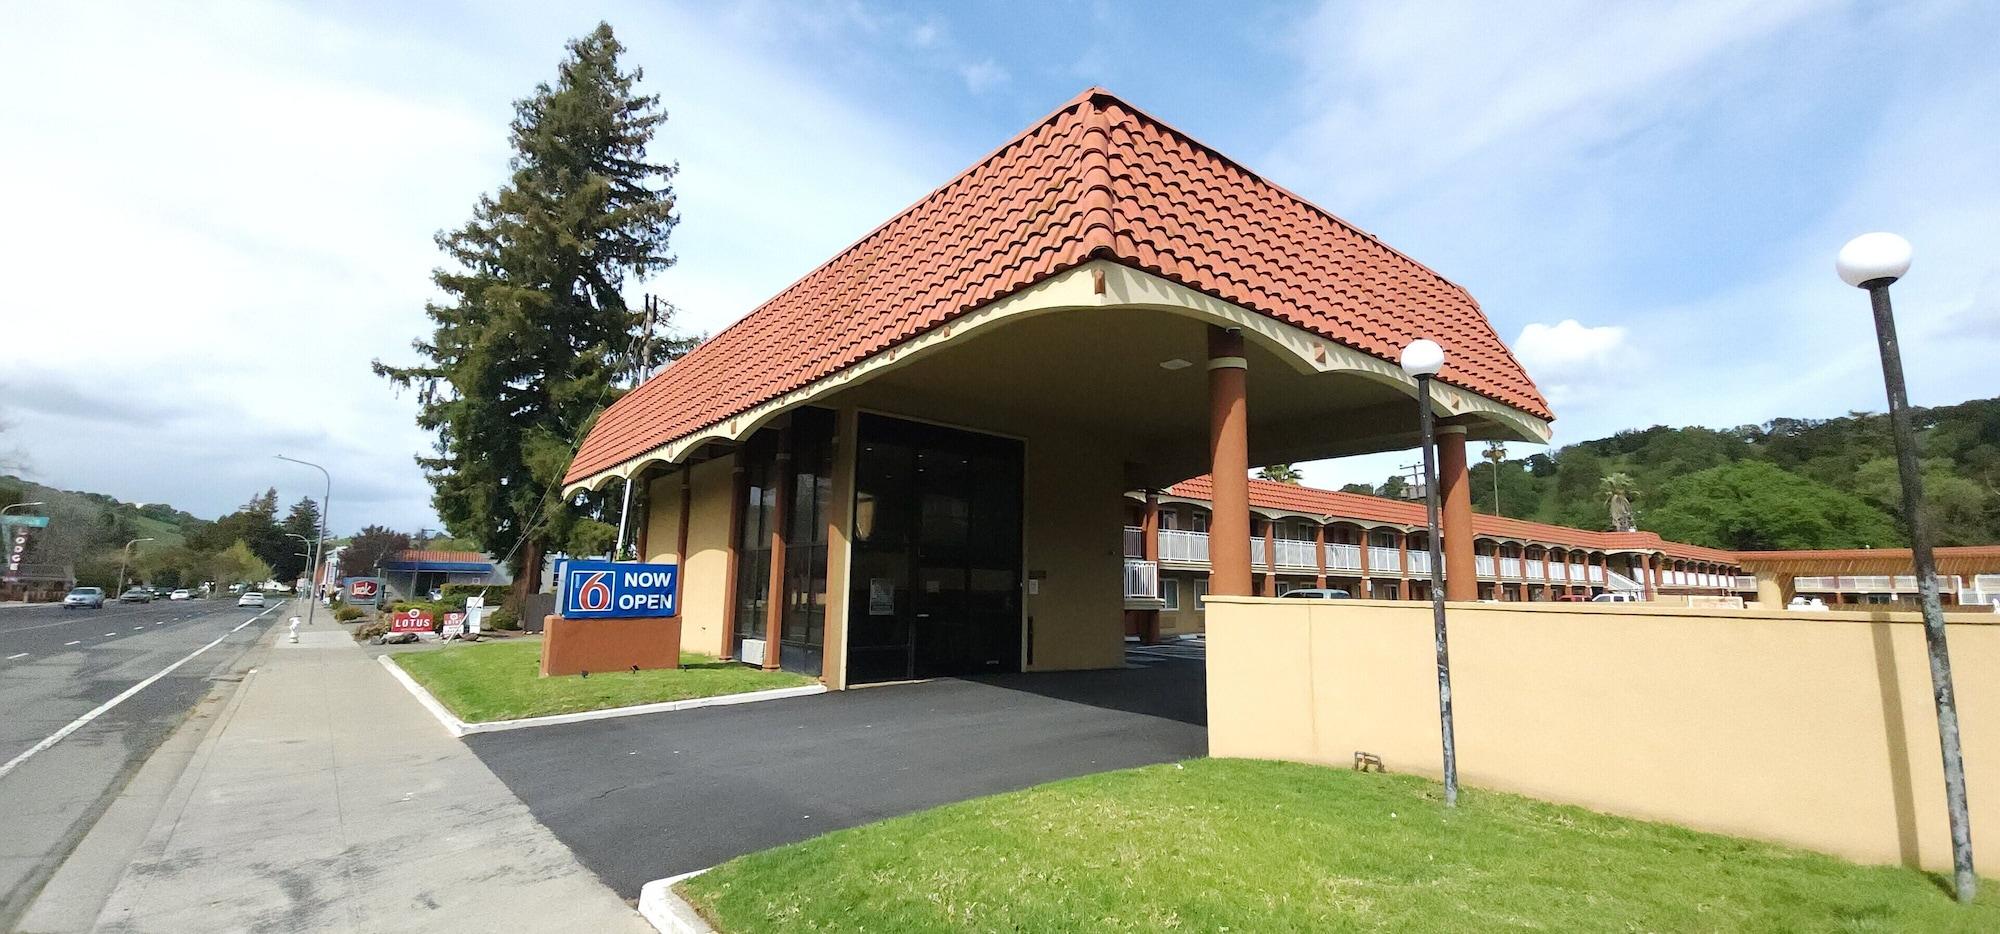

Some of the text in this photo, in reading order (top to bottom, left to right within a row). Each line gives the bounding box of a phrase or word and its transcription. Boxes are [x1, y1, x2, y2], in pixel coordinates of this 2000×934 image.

[625, 572, 671, 587] NOW
[579, 571, 611, 611] 6
[619, 595, 672, 610] OPEN
[395, 618, 430, 628] LOTUS
